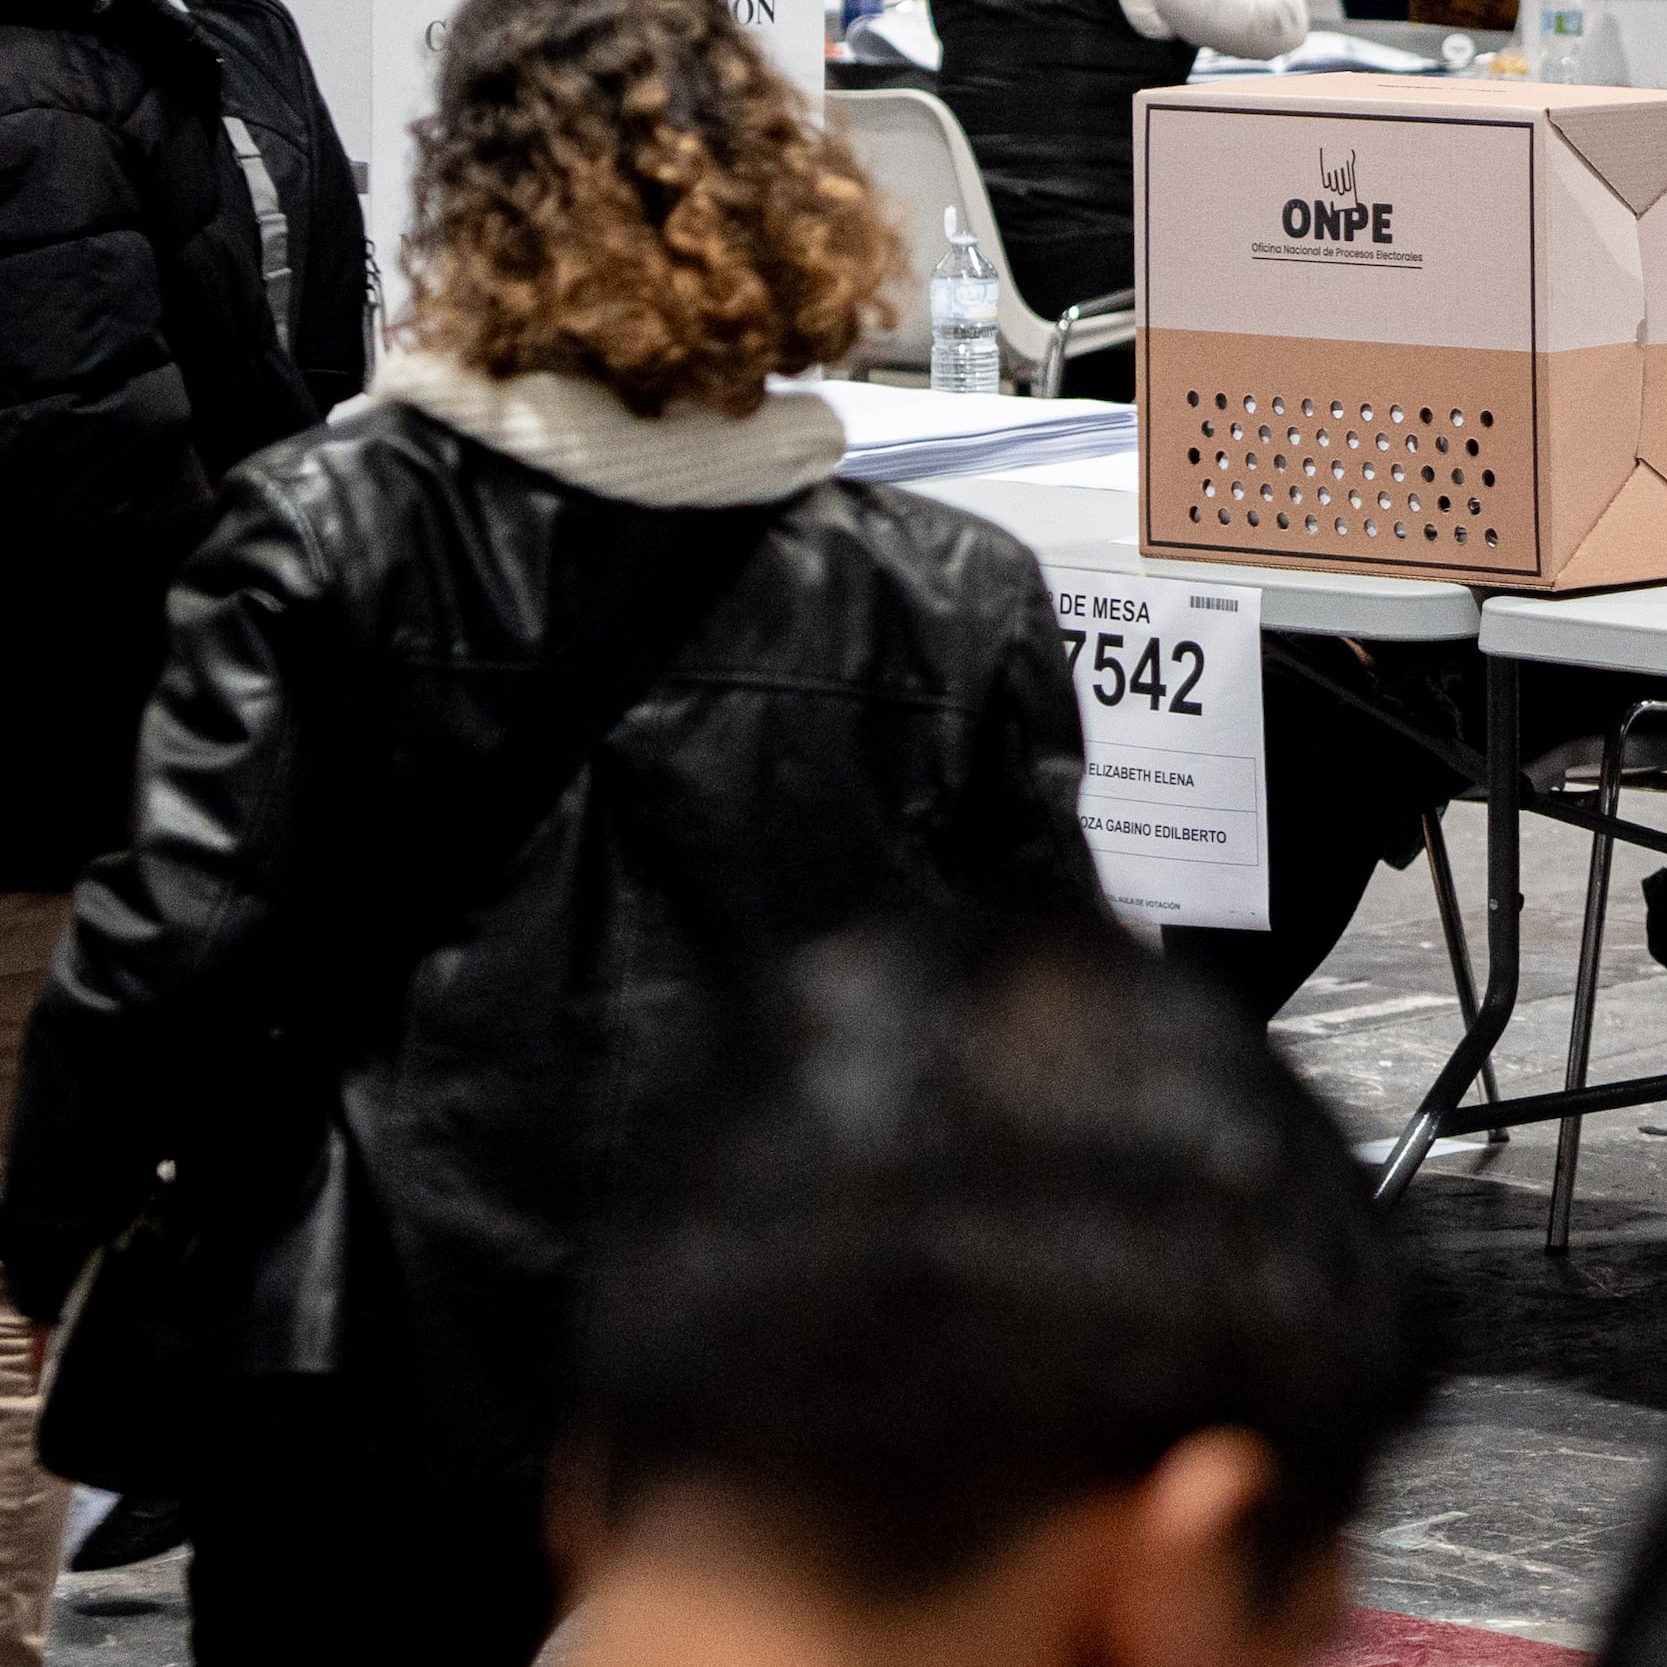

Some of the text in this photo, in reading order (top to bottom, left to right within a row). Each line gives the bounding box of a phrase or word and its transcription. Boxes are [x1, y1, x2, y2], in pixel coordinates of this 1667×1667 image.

[1282, 198, 1393, 244] ONPE
[1251, 242, 1423, 262] Oficina Nacional de Procesos Electorales
[1060, 593, 1086, 617] DE
[1093, 596, 1150, 624] MESA
[1061, 628, 1205, 716] 7542
[1088, 762, 1195, 787] ELIZABETH ELENA
[1079, 815, 1227, 844] OZA GABINO EDILBERTO
[1145, 898, 1181, 911] VOTACIÓN
